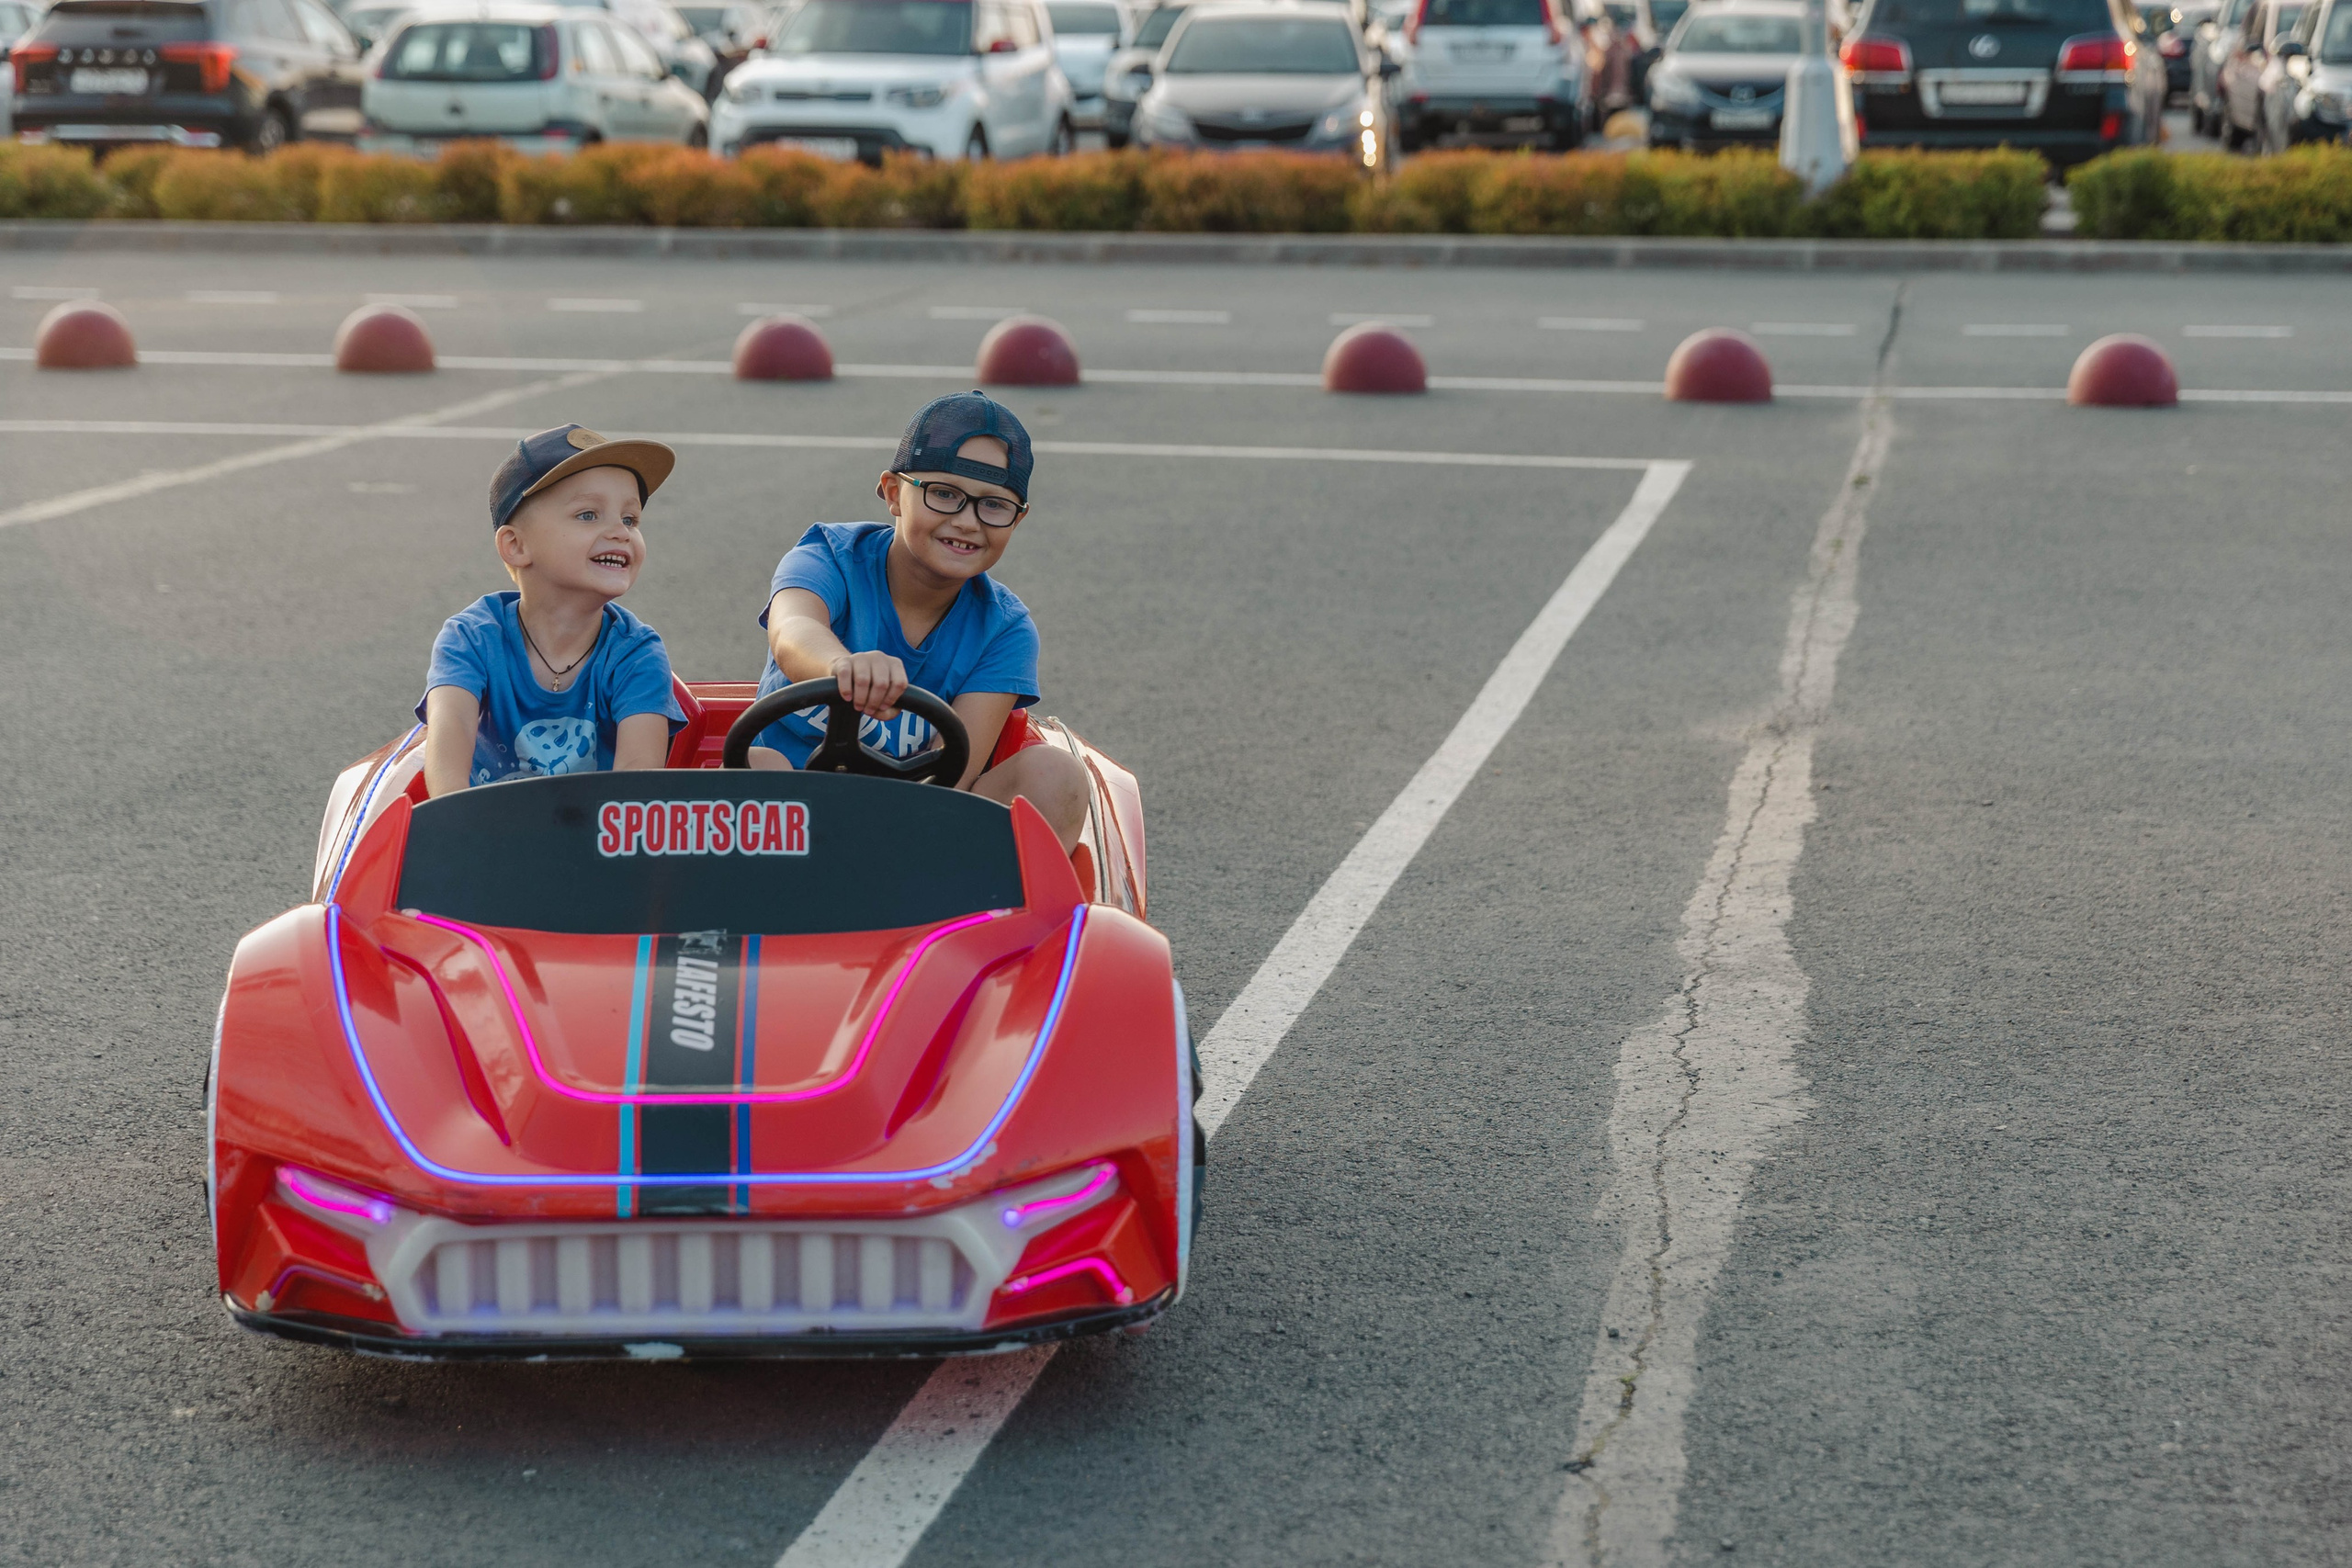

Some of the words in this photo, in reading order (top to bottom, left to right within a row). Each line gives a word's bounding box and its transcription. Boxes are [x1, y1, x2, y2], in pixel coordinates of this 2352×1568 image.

[598, 800, 735, 856] SPORTS
[737, 800, 809, 855] CAR
[670, 956, 718, 1052] LAFESTO
